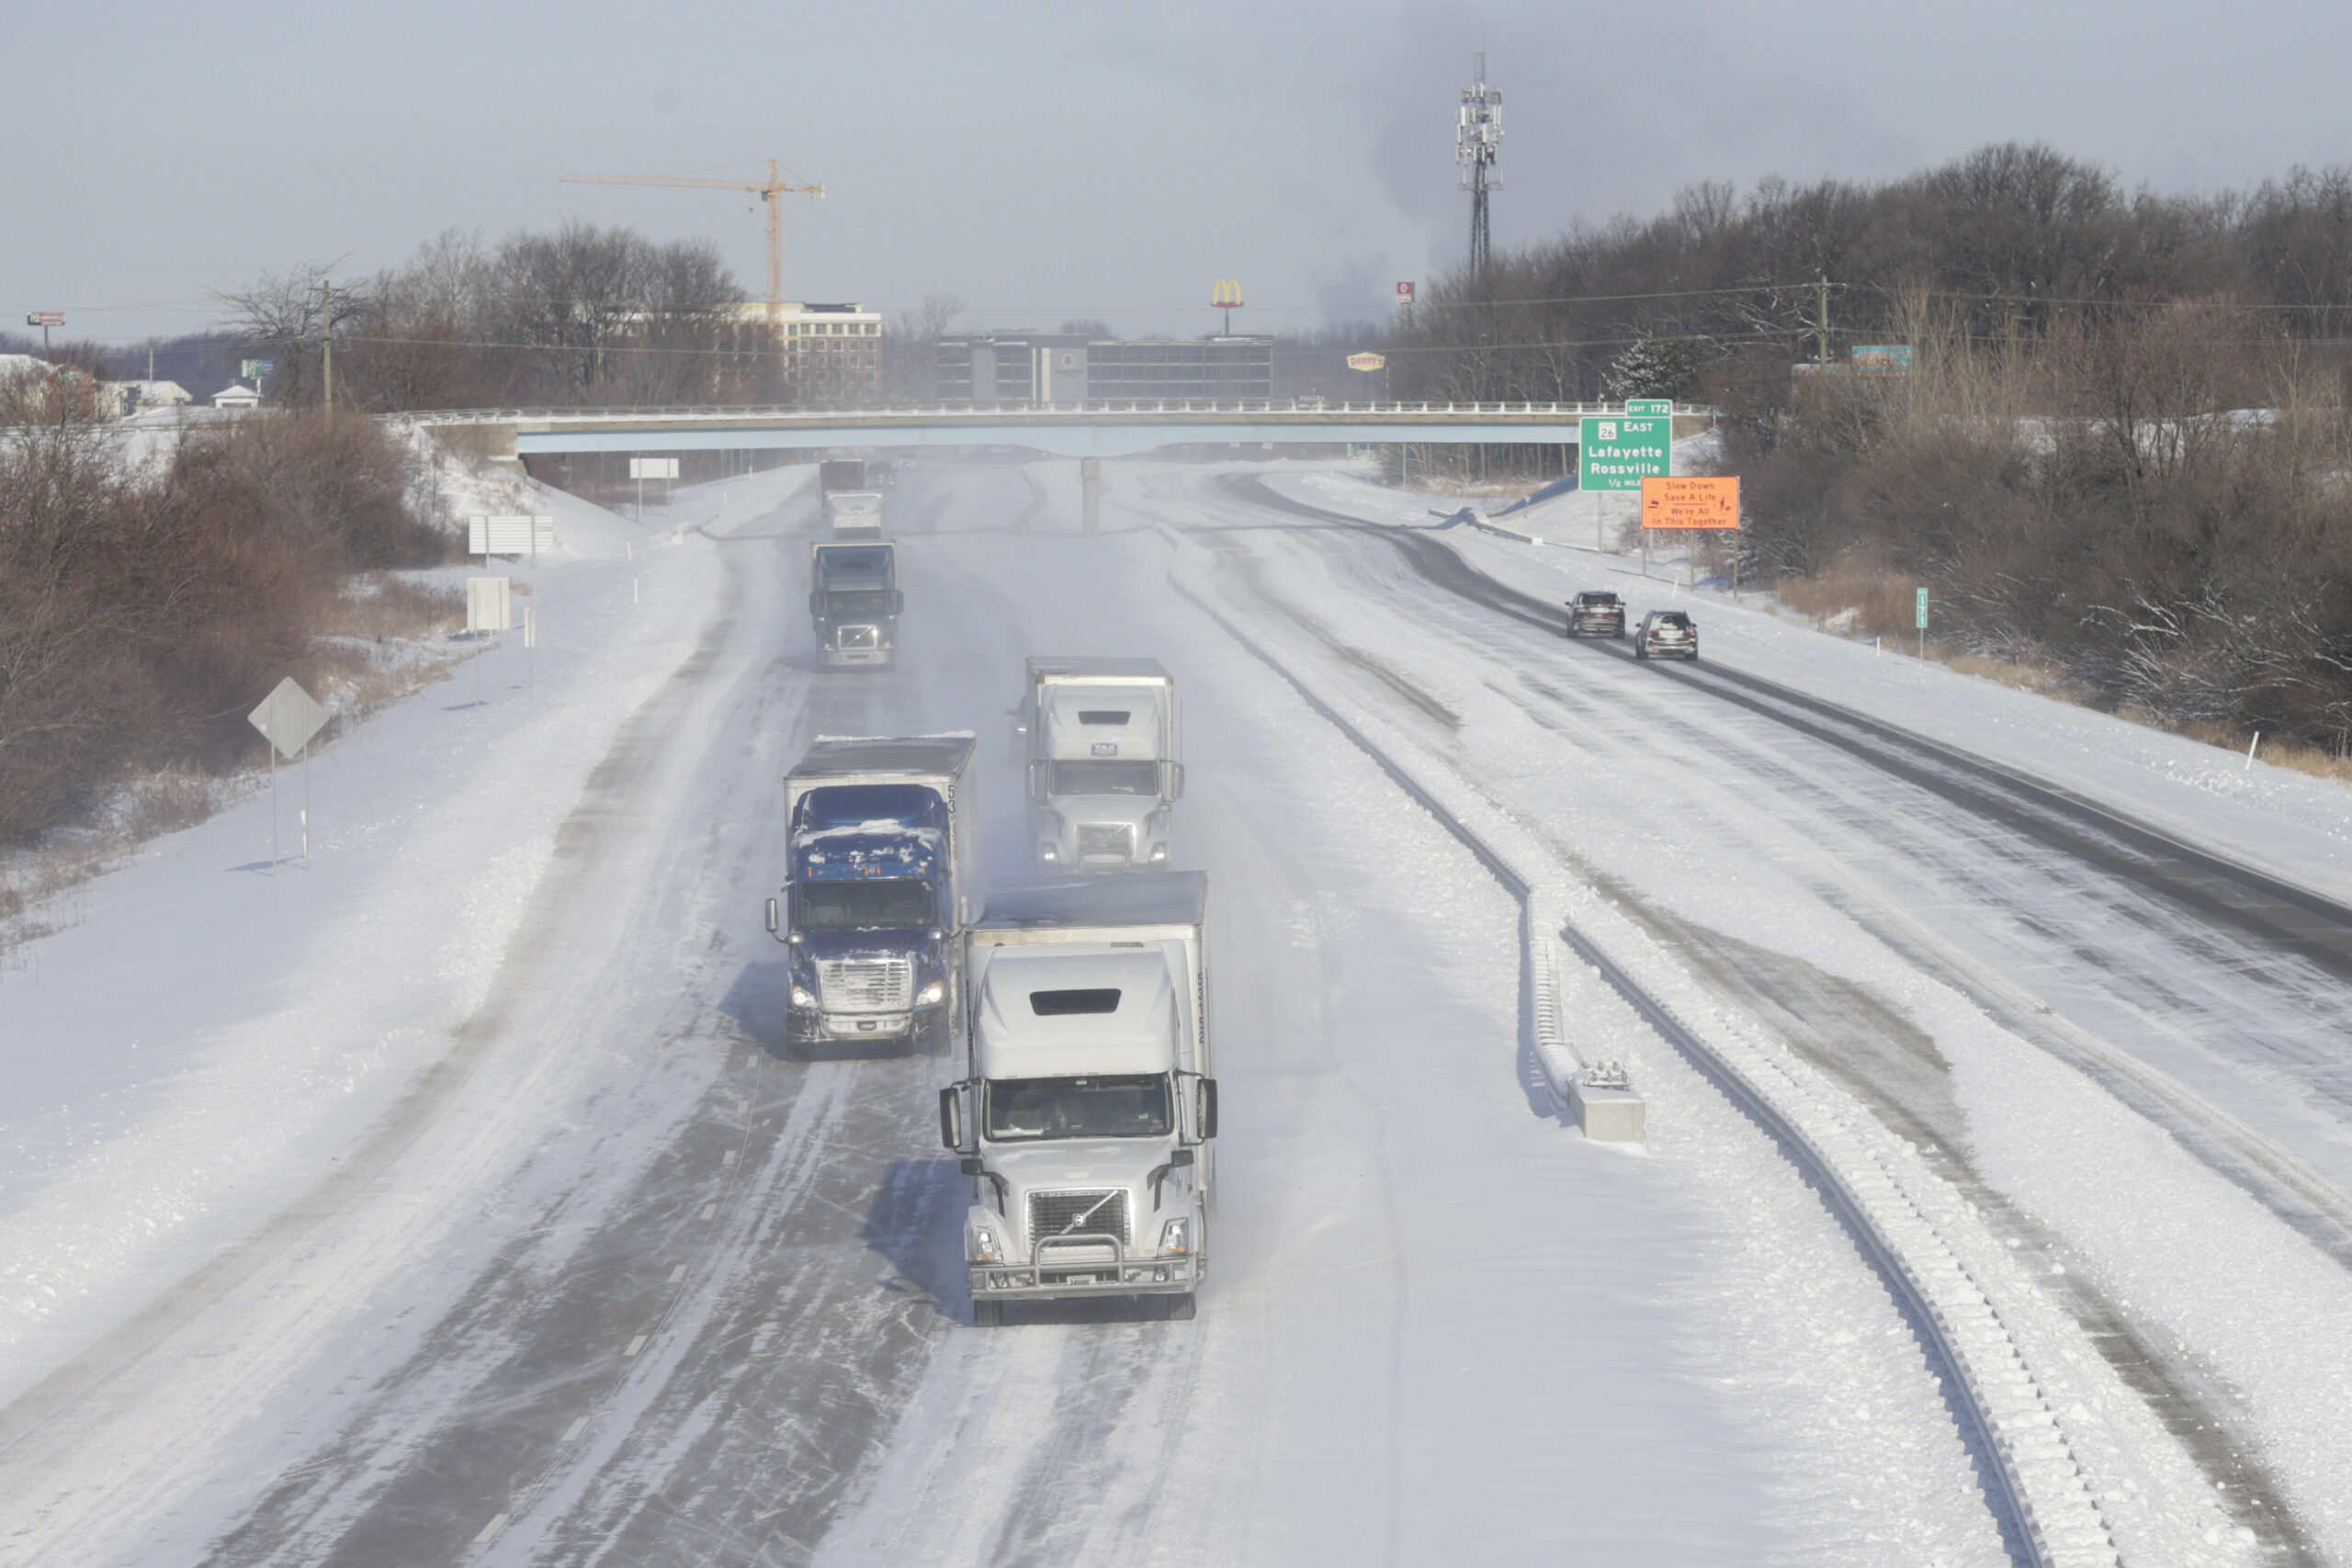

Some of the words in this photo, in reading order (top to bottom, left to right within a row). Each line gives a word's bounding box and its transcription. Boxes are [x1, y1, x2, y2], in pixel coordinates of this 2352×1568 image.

[1349, 355, 1384, 367] Denny's
[1650, 404, 1669, 413] 172
[1600, 428, 1614, 438] 26
[1623, 421, 1654, 432] EAST
[1589, 446, 1662, 459] Lafayette
[1590, 462, 1660, 474] Rossville
[1666, 481, 1687, 490] Slow
[1690, 481, 1715, 490] Down
[1664, 493, 1686, 502] Save
[1689, 493, 1696, 502] A
[1699, 493, 1717, 502] Life
[1687, 517, 1727, 526] Together
[1918, 595, 1927, 626] 171
